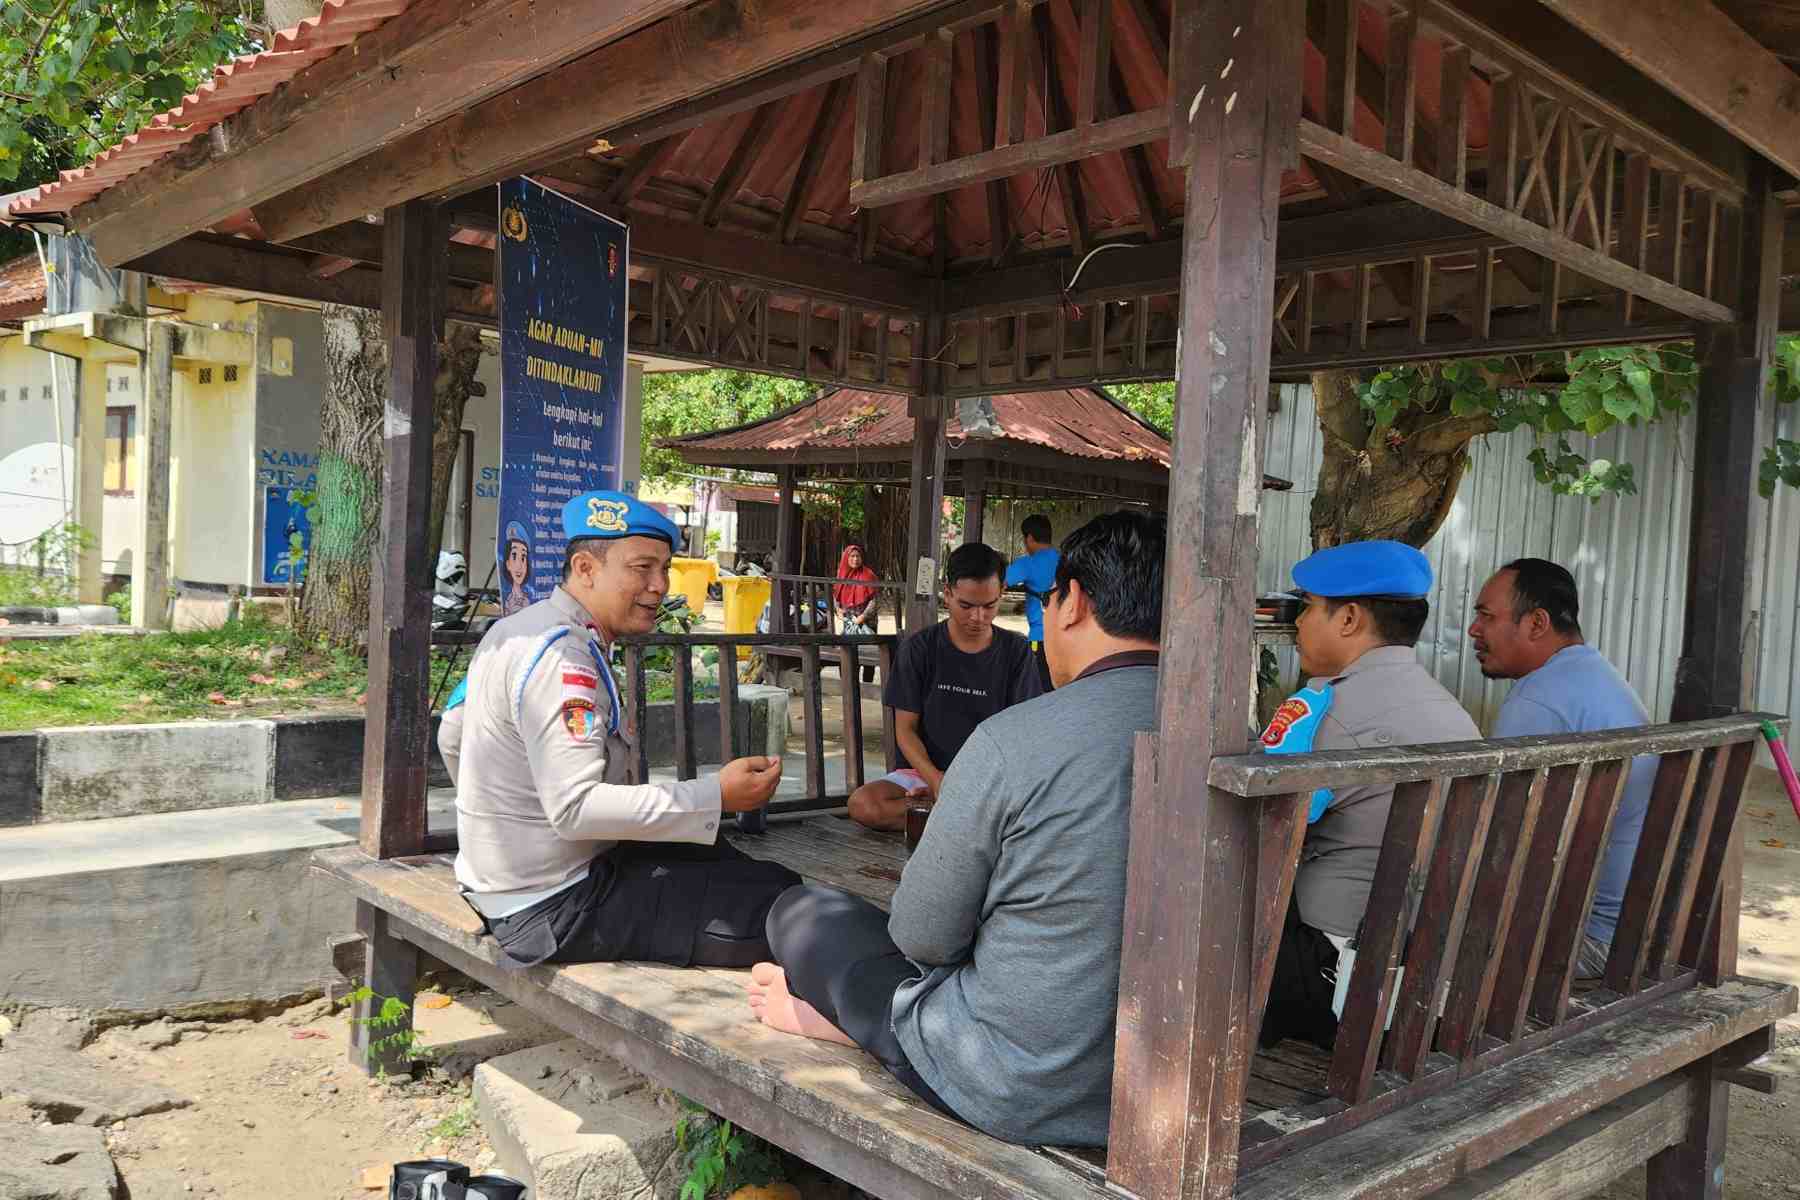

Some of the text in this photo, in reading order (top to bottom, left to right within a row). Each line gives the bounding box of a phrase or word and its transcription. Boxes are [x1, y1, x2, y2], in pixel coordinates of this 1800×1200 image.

[528, 318, 604, 358] AGAR ADUAN-MU
[526, 355, 602, 393] DITINDAKLANJUTI
[543, 401, 603, 428] Lengkapi hal-hal
[553, 430, 580, 450] berikut
